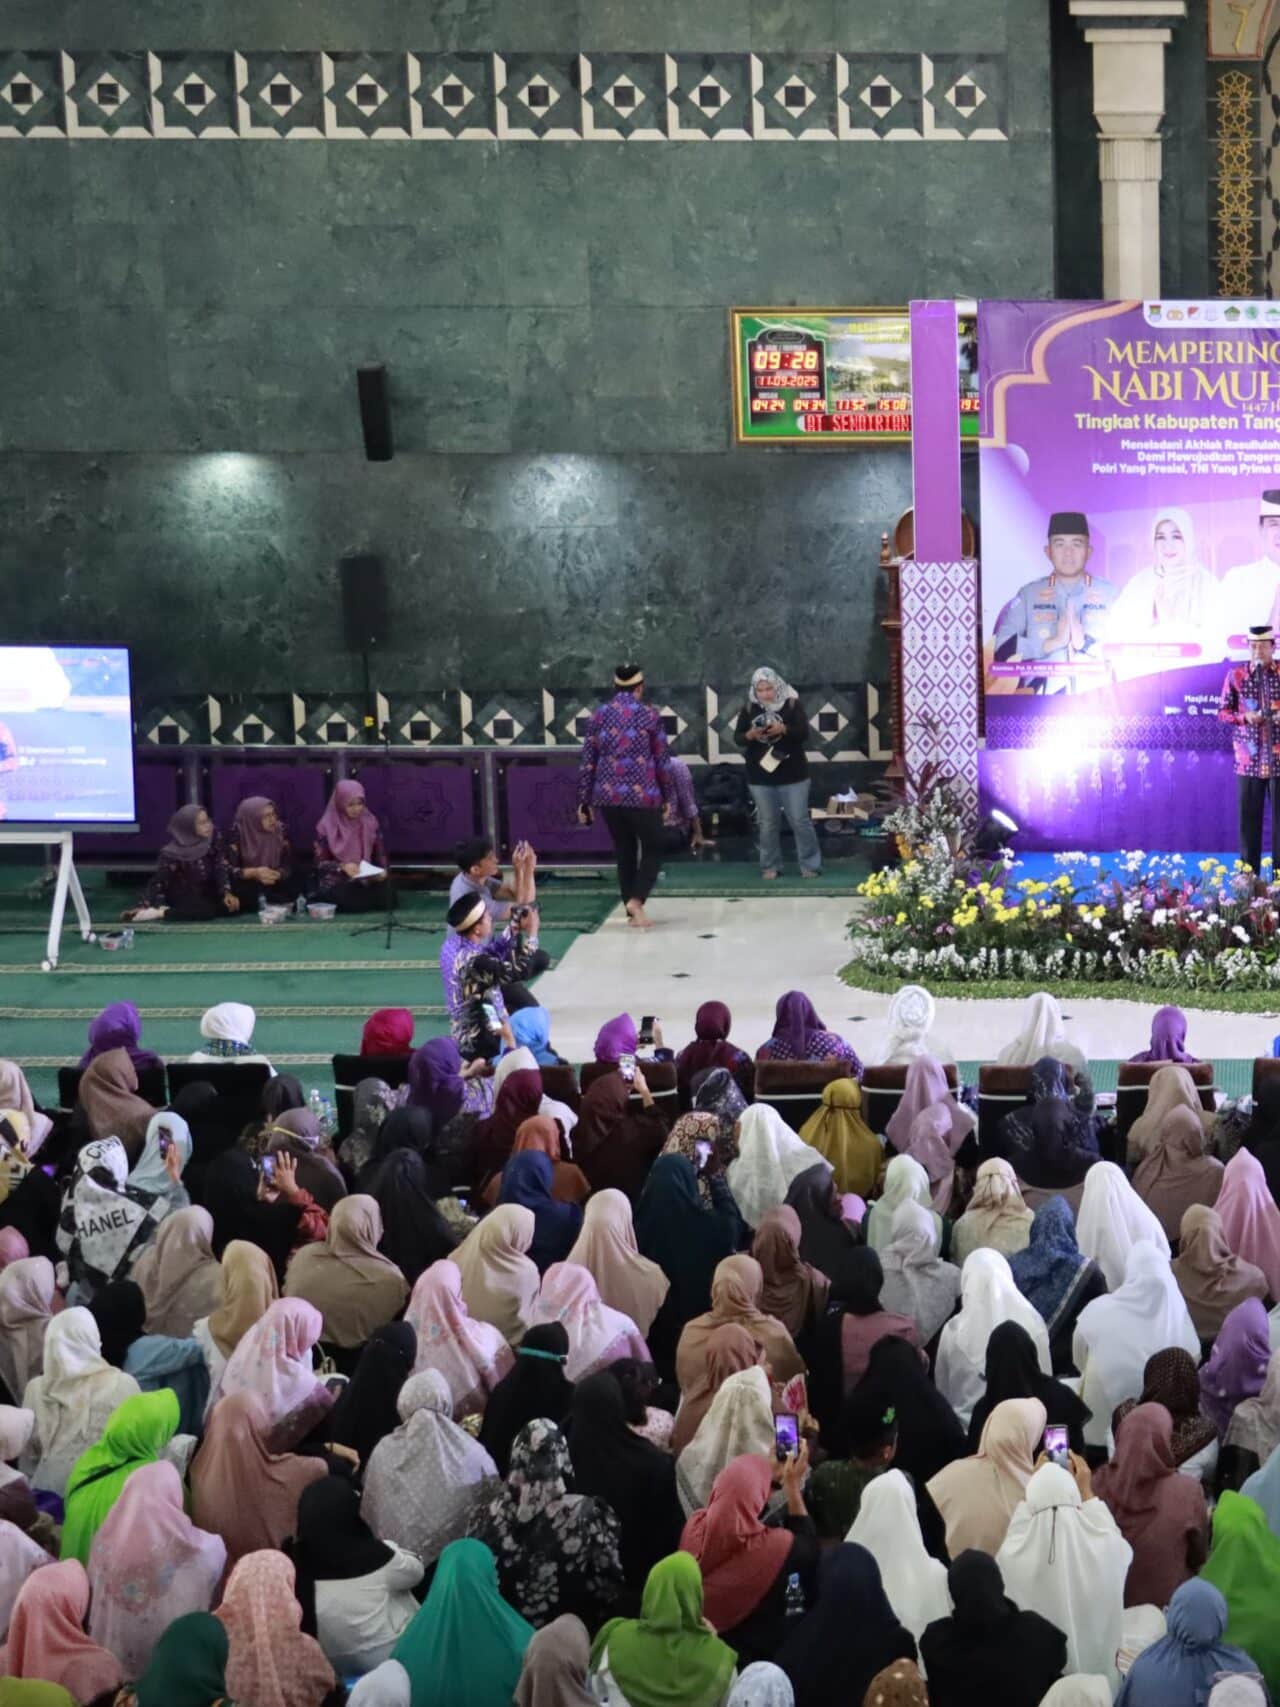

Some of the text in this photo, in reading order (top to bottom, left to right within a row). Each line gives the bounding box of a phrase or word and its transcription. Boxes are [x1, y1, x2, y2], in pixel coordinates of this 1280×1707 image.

[755, 351, 818, 369] 09:28
[1081, 365, 1184, 408] NABI
[1074, 413, 1140, 432] Tingkat
[1144, 413, 1239, 432] Kabupaten
[1119, 463, 1146, 475] Yang
[1211, 463, 1238, 476] Yang
[78, 1207, 134, 1238] HANEL
